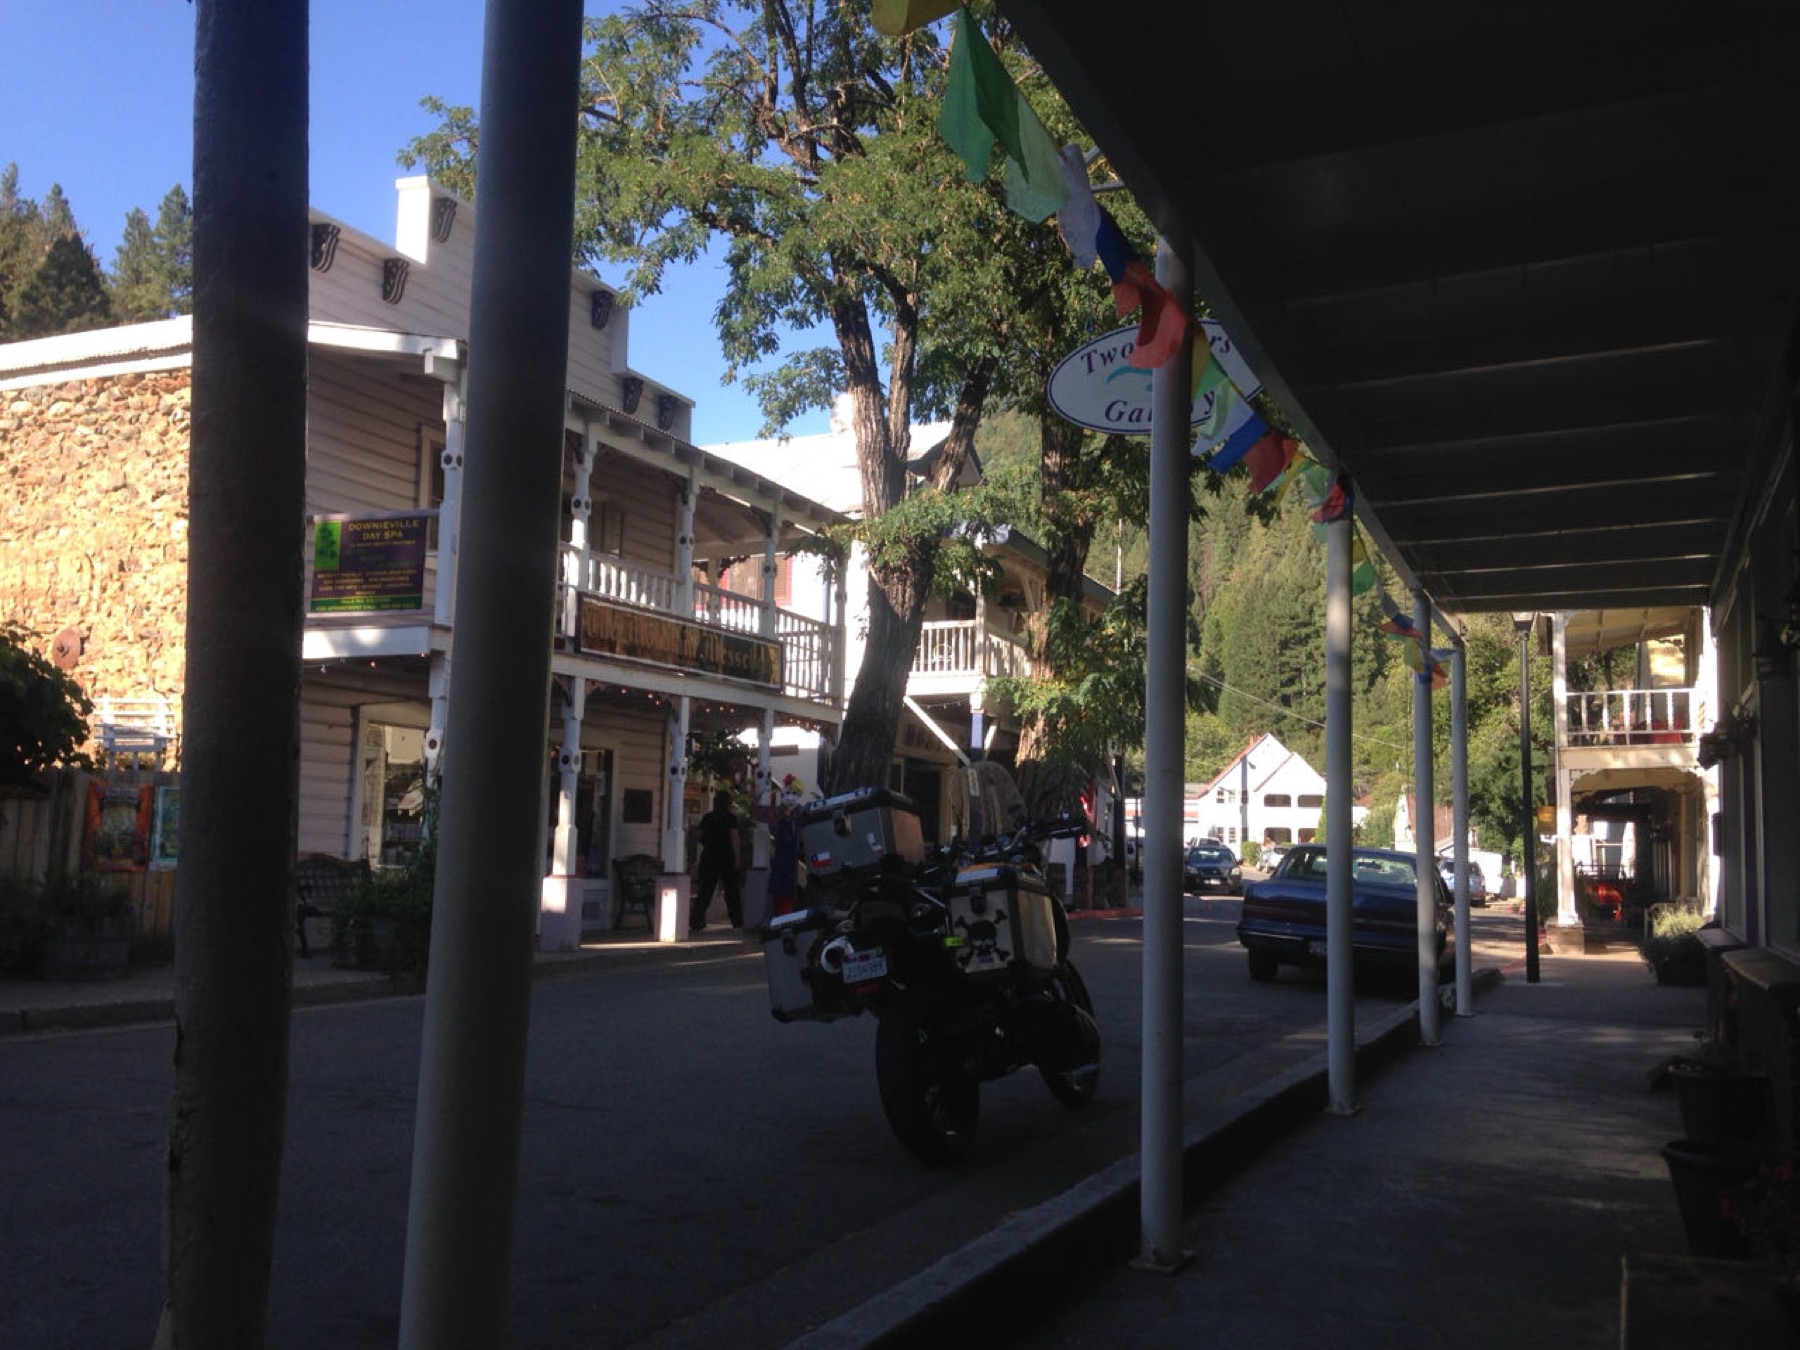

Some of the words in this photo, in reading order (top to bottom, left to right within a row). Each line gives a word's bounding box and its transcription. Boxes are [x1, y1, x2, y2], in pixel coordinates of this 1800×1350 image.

[1080, 342, 1134, 375] Two
[349, 520, 419, 530] DOWNIEVILLE
[362, 531, 381, 541] DAY
[384, 530, 403, 540] SPA
